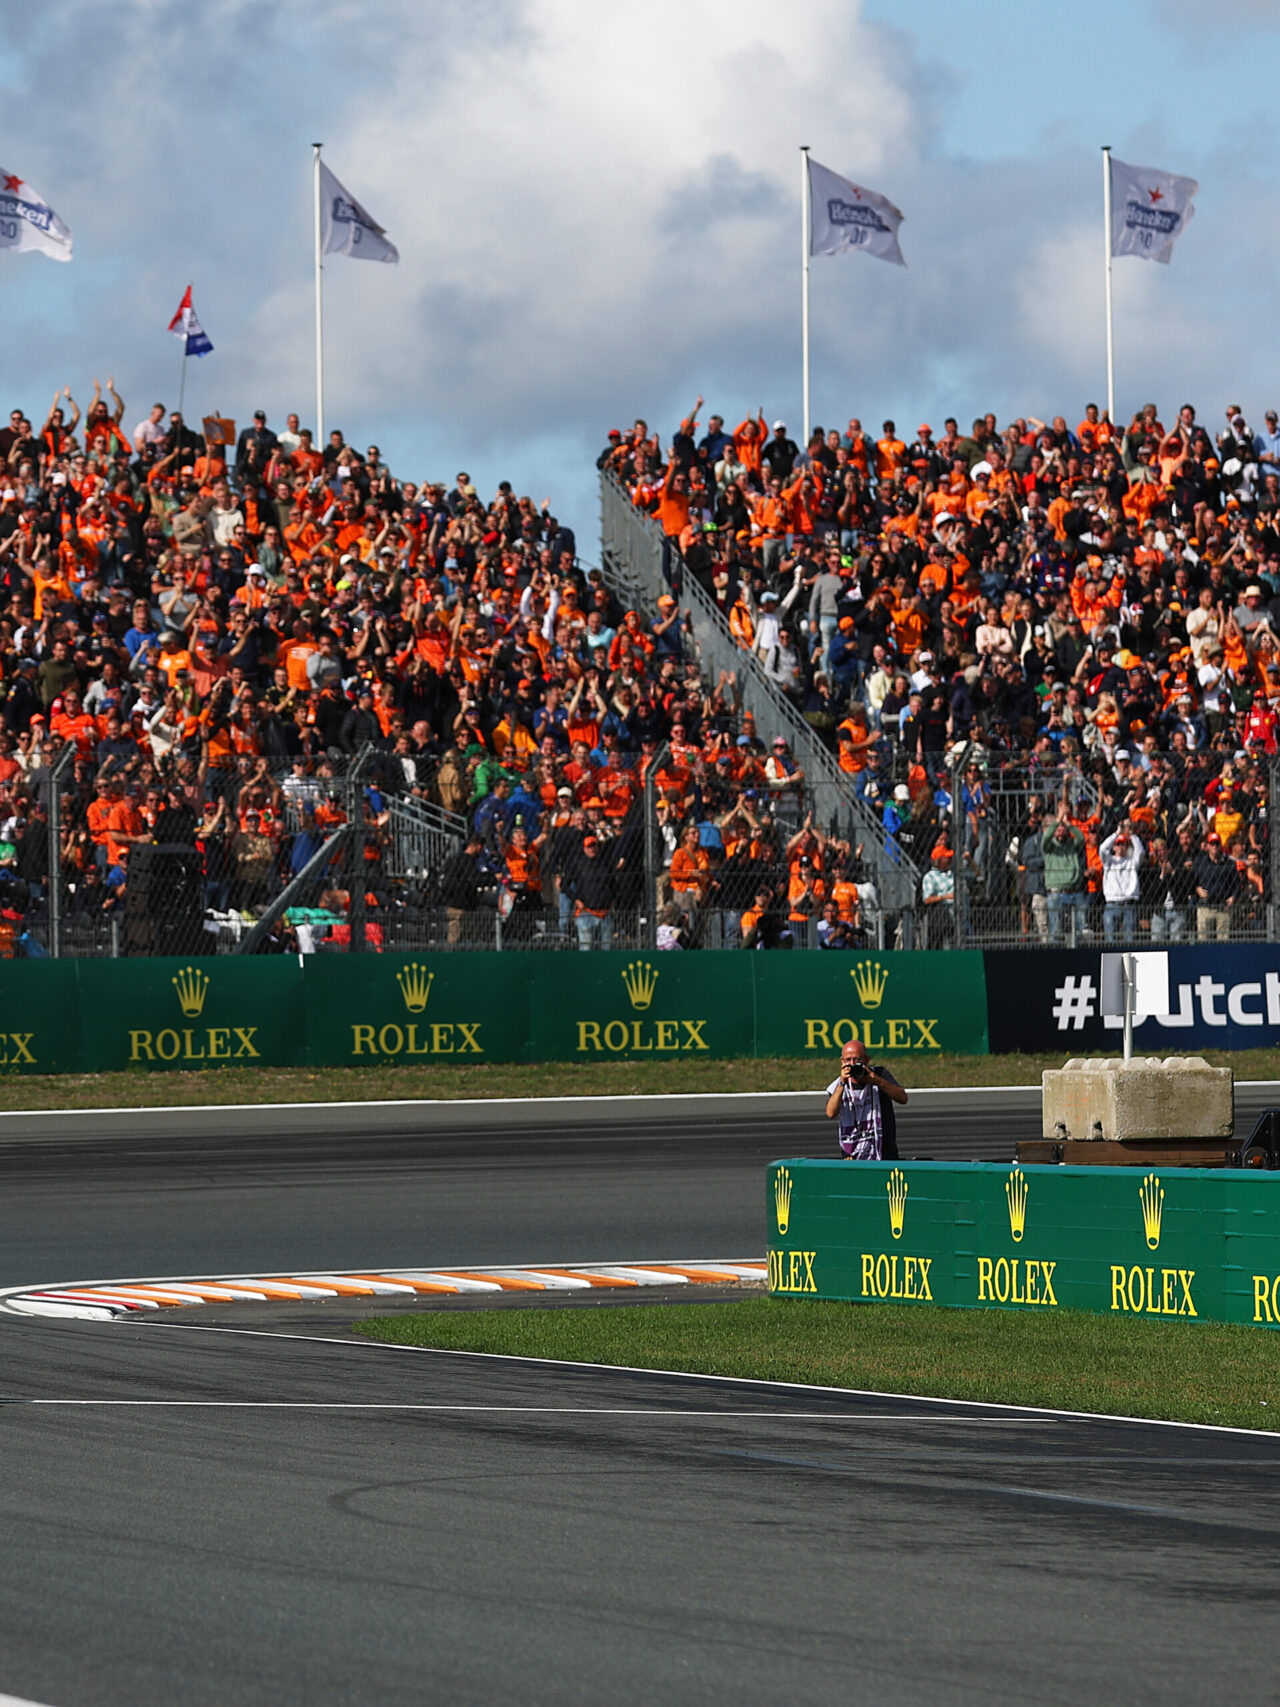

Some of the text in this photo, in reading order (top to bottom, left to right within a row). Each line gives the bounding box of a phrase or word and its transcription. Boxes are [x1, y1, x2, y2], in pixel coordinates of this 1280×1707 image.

[1053, 973, 1280, 1030] #utc
[130, 1028, 261, 1060] ROLEX
[352, 1024, 483, 1054] ROLEX
[578, 1021, 709, 1051] ROLEX
[805, 1019, 941, 1050] ROLEX
[766, 1250, 818, 1292] OLEX
[861, 1253, 933, 1300] ROLEX
[977, 1257, 1058, 1305] ROLEX
[1110, 1265, 1198, 1317] ROLEX
